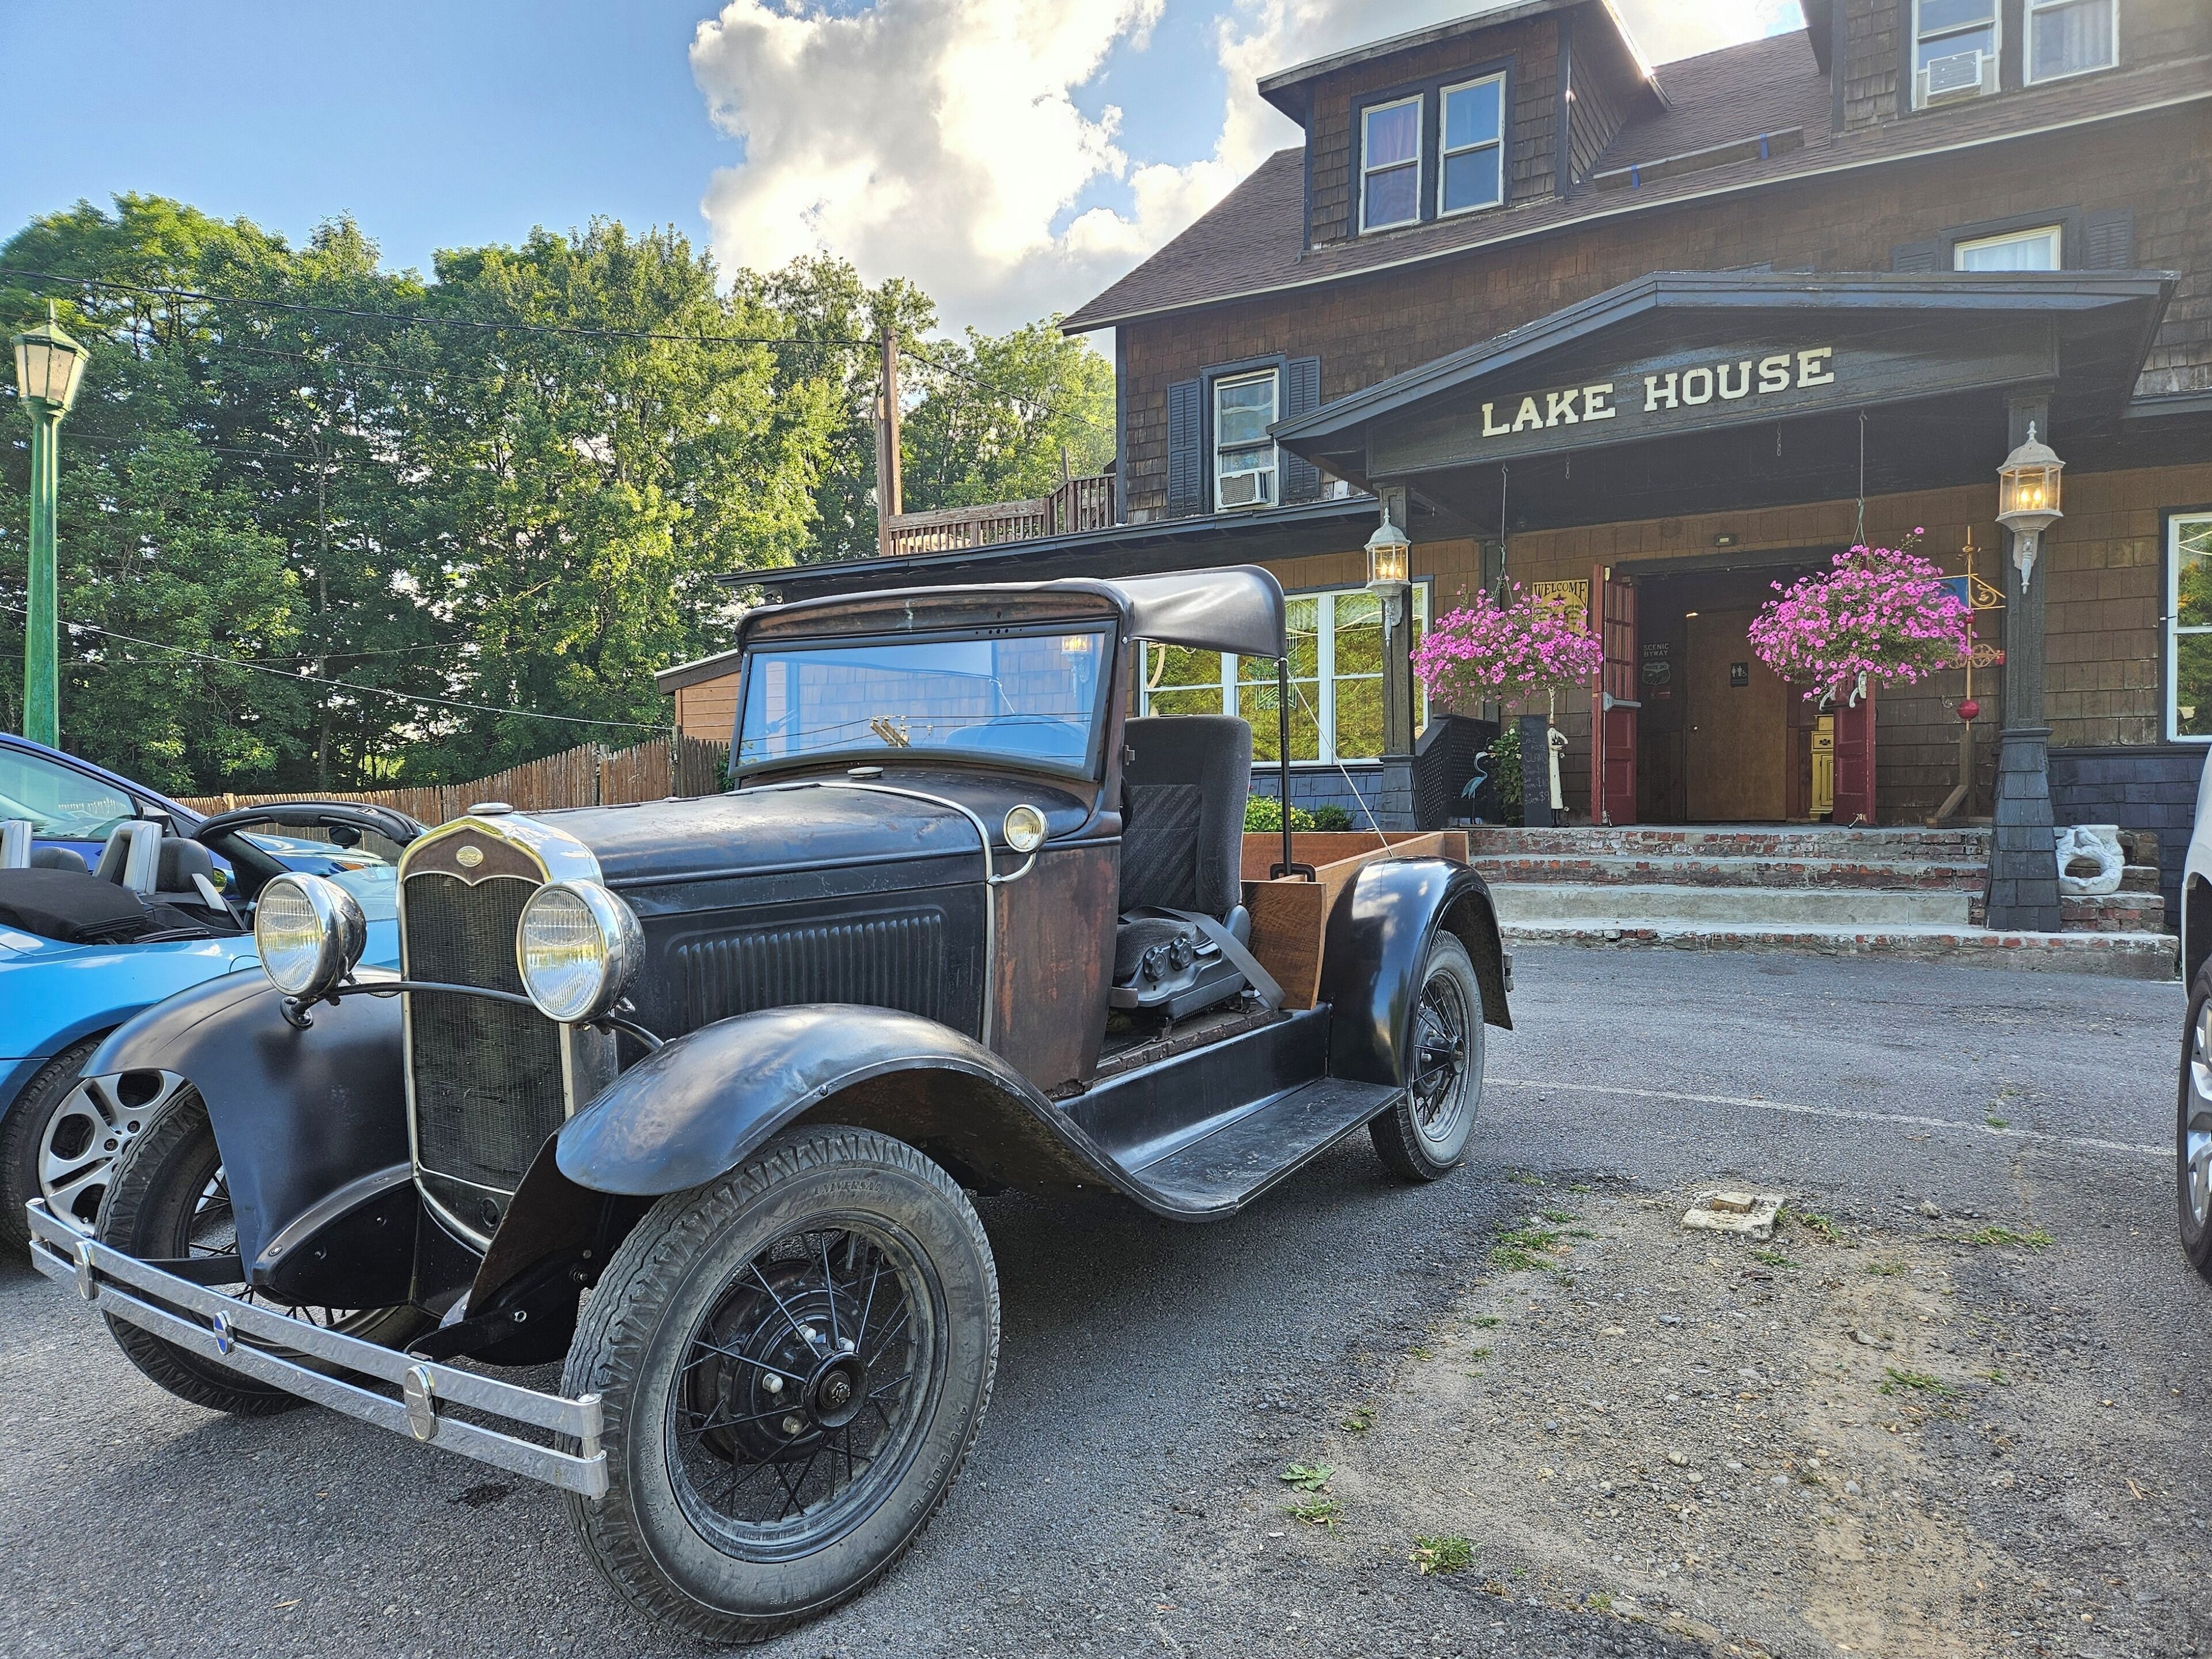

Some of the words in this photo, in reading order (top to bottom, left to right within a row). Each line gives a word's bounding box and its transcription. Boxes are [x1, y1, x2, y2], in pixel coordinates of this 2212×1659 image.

[1482, 384, 1616, 437] LAKE
[1644, 347, 1834, 411] HOUSE
[1534, 581, 1587, 607] WELCOME
[1643, 643, 1669, 651] SCENIC
[1524, 752, 1548, 764] CLAMS
[1536, 776, 1550, 788] $10
[1539, 790, 1550, 804] $9
[458, 850, 478, 862] Ford
[815, 1180, 881, 1195] UNIVERSAL
[646, 1502, 662, 1524] PLY
